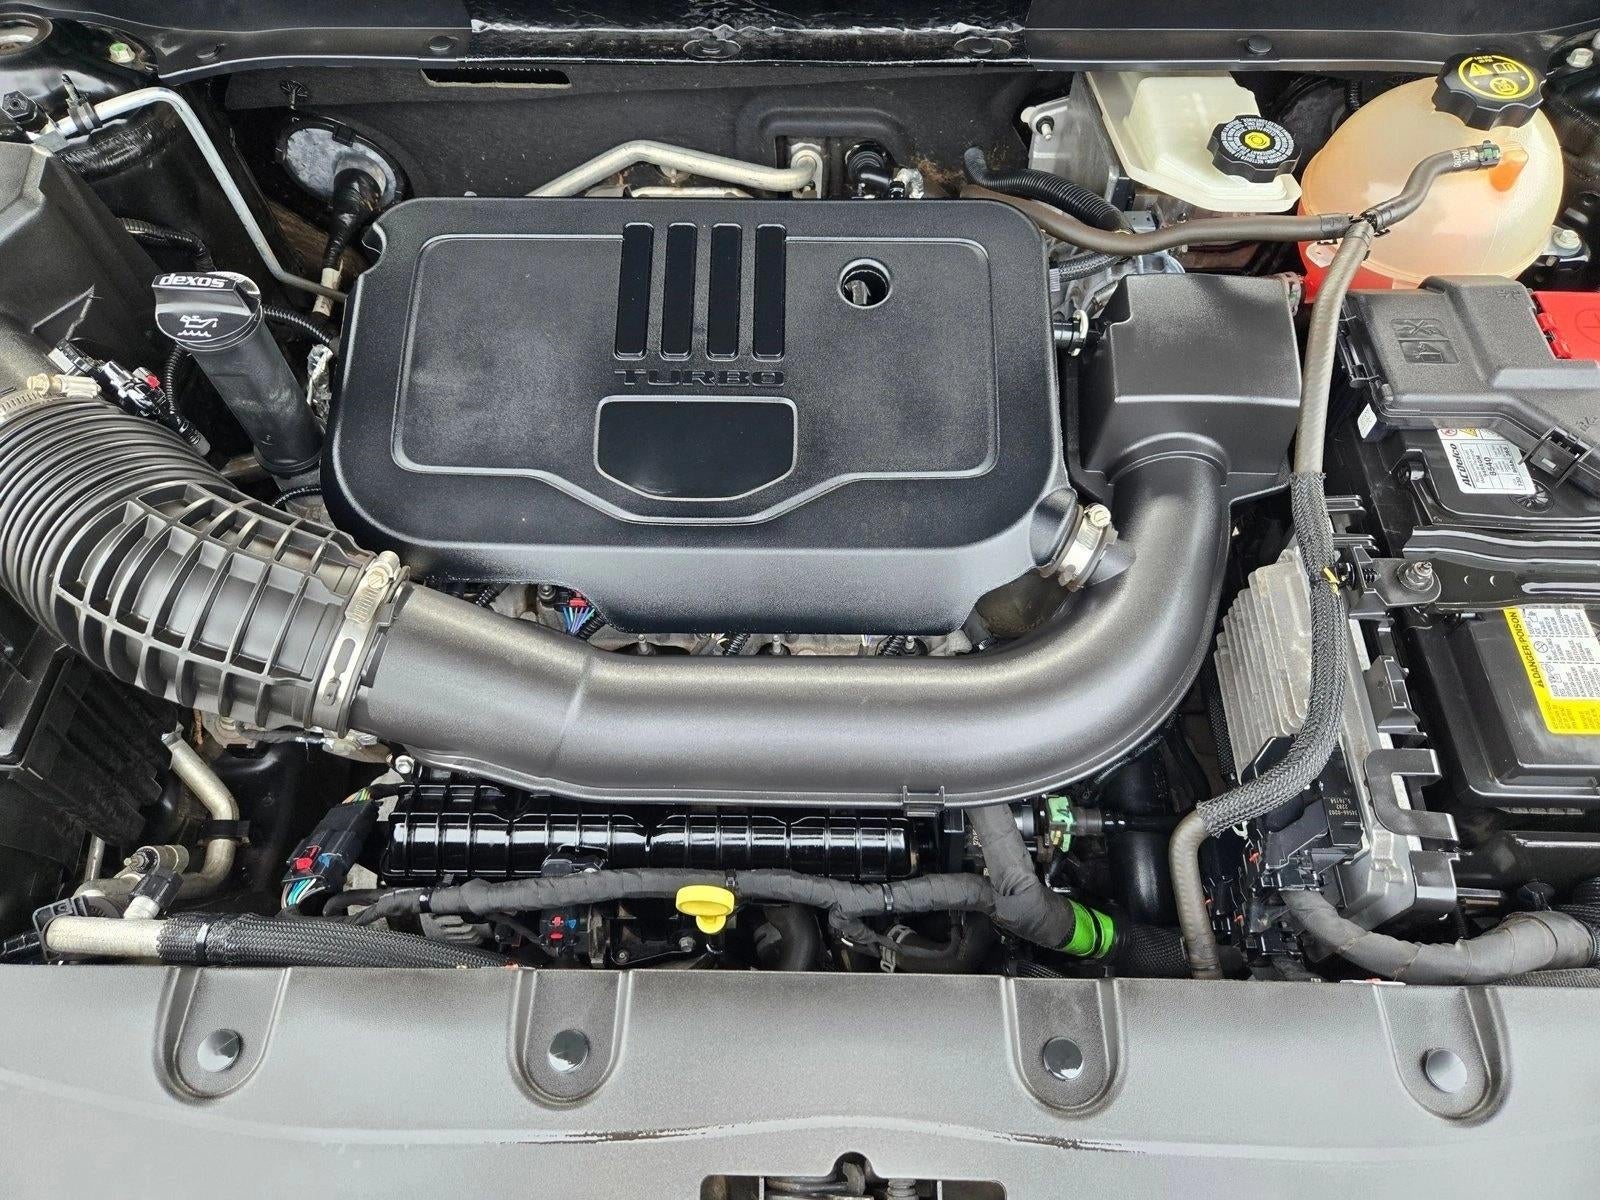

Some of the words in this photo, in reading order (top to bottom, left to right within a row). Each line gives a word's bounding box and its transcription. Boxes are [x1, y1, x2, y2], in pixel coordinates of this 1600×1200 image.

[158, 272, 228, 289] dexos
[614, 369, 785, 387] TURBO
[1450, 443, 1472, 487] ACDelco
